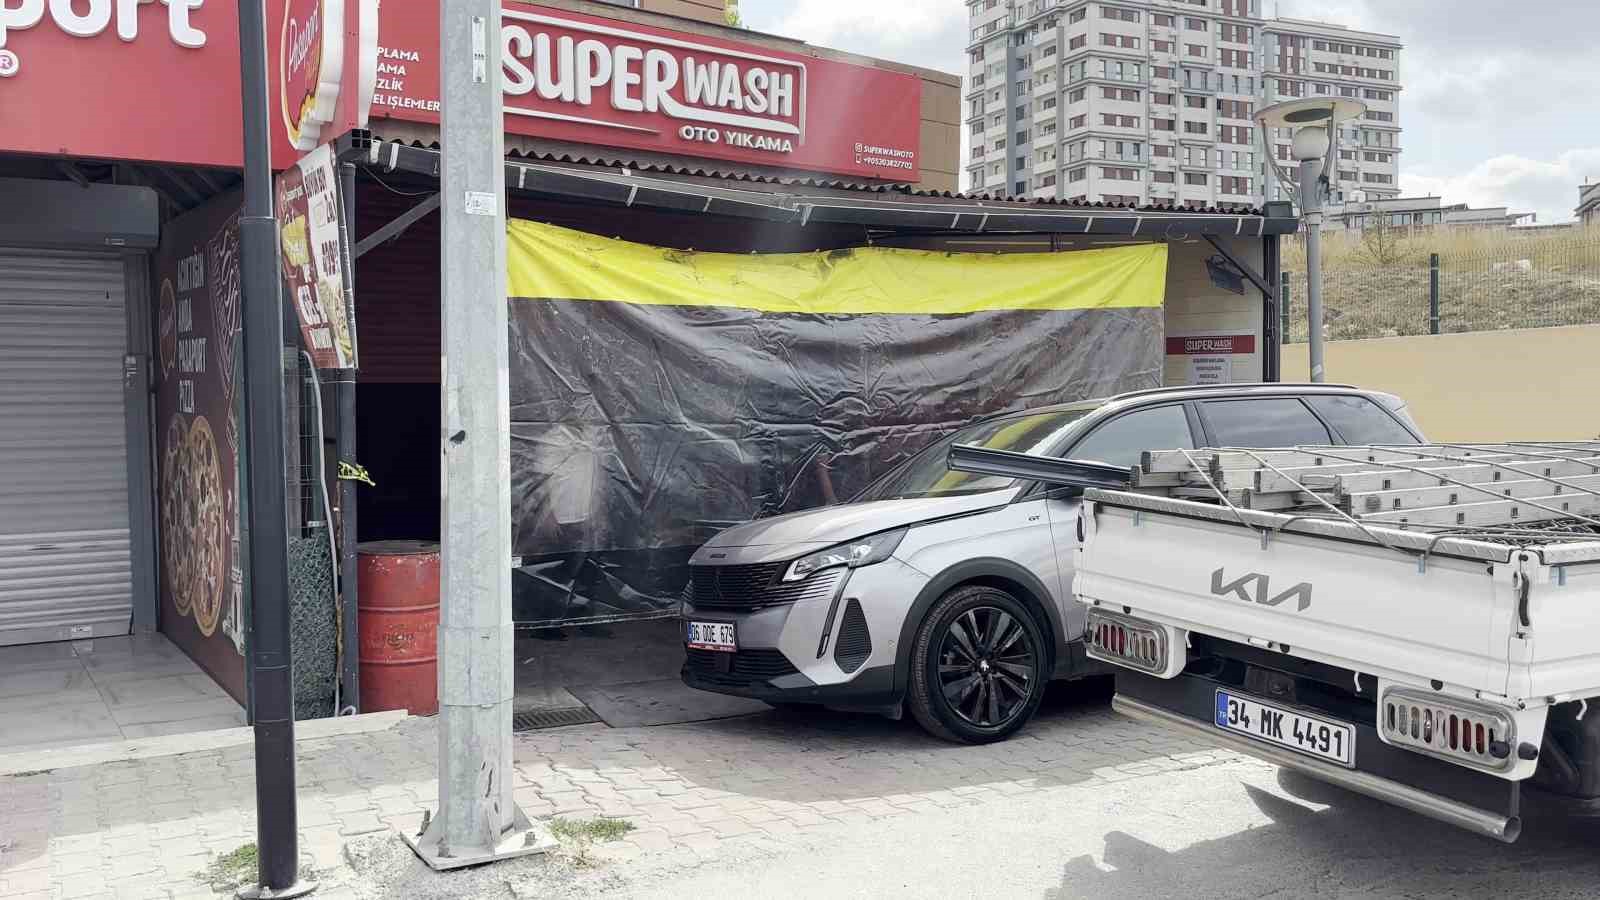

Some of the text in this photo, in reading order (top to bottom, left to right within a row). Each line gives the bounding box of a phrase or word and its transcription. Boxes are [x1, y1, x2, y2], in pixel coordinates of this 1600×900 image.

[679, 124, 793, 153] OTO YIKAMA
[1211, 567, 1312, 611] KIA
[720, 626, 733, 645] 679
[1228, 700, 1250, 729] 34
[1260, 708, 1283, 739] MK
[1293, 718, 1342, 758] 4491
